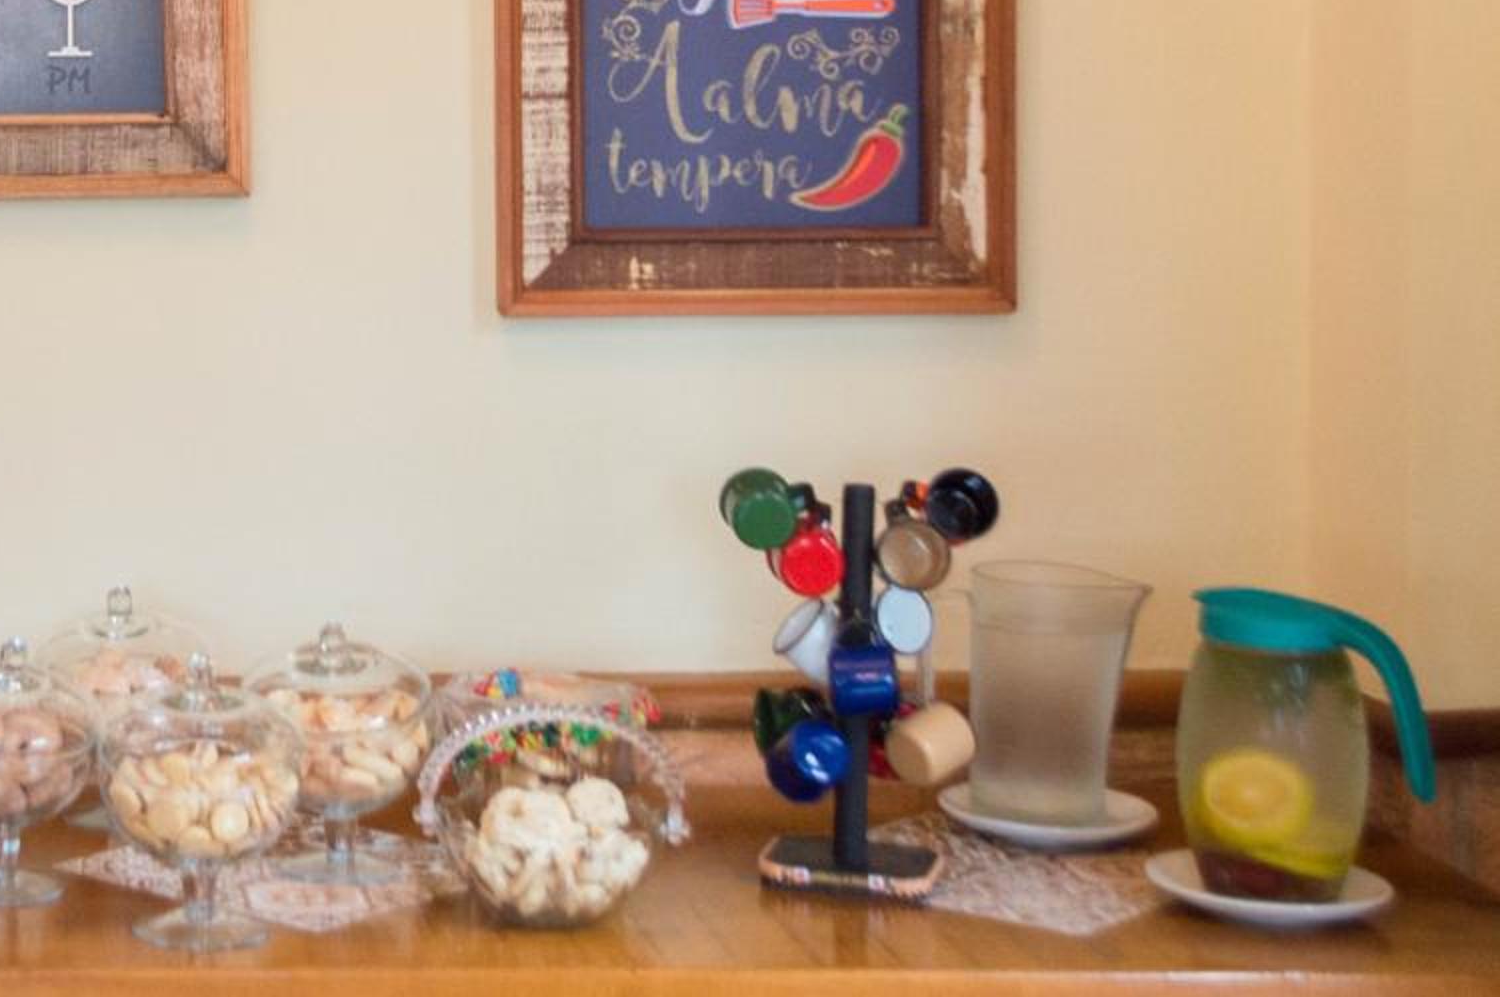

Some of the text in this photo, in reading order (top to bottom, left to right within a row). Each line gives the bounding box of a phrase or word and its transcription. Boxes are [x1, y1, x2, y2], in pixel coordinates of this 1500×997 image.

[48, 67, 91, 94] PM
[607, 20, 878, 144] A alma
[605, 128, 812, 213] tempera
